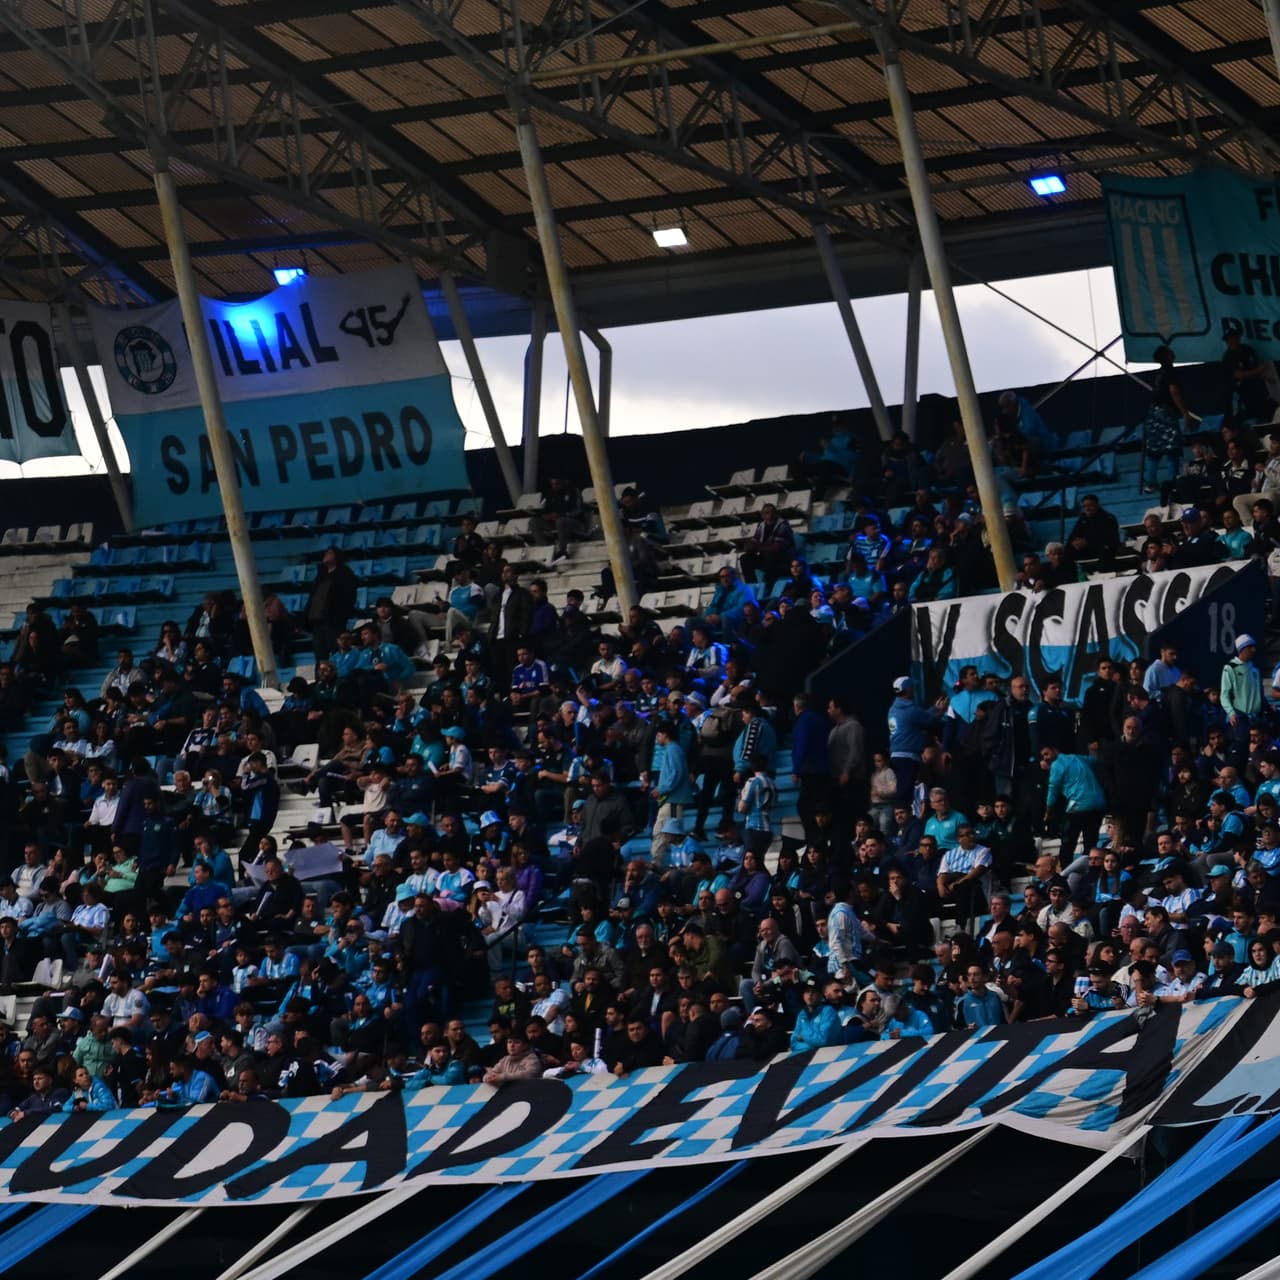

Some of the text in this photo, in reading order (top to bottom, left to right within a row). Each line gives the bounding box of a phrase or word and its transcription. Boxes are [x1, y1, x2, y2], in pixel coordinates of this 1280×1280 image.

[1109, 199, 1181, 224] RACING
[183, 303, 339, 376] ILIAL
[268, 406, 432, 484] PEDRO
[1207, 602, 1236, 655] 18
